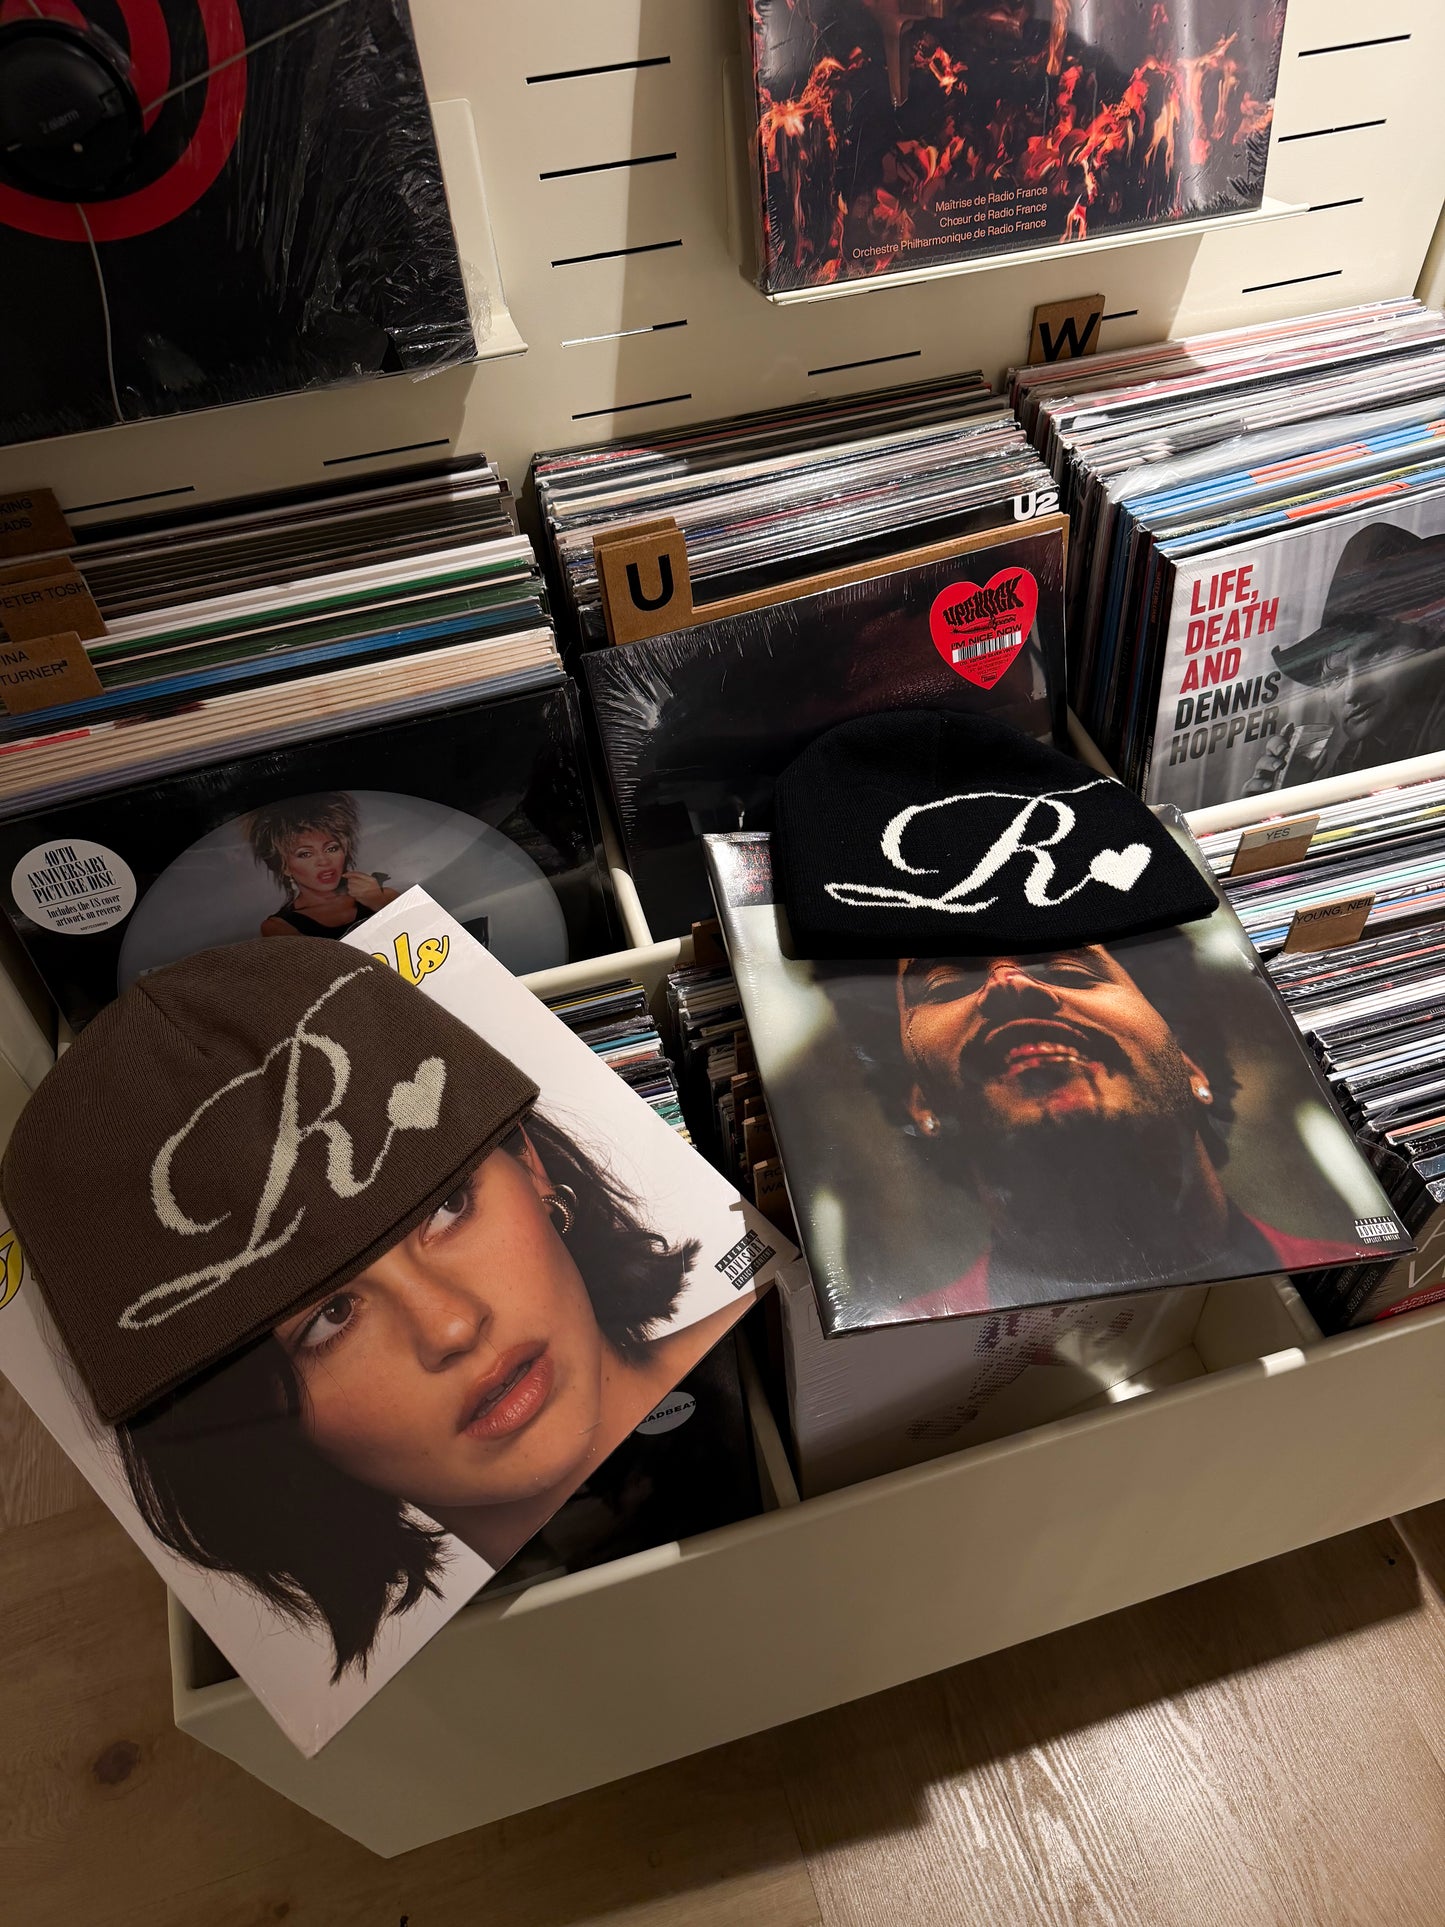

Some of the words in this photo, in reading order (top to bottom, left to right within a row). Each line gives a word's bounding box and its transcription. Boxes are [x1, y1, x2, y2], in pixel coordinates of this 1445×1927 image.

[935, 199, 973, 212] Maîtrise
[974, 196, 987, 206] de
[988, 192, 1014, 204] Radio
[1016, 186, 1048, 198] France
[939, 214, 972, 229] Chœur
[974, 211, 986, 222] de
[988, 207, 1014, 220] Radio
[1015, 202, 1047, 215] France
[852, 243, 899, 259] Orchestre
[901, 232, 972, 251] Philharmonique
[973, 227, 986, 238] de
[988, 223, 1014, 236] Radio
[1015, 219, 1047, 232] France
[1039, 312, 1101, 362] W
[1013, 490, 1060, 521] U2
[45, 581, 90, 598] TOSH
[625, 554, 674, 612] U
[1190, 564, 1259, 616] LIFE,
[951, 641, 965, 649] I'M
[969, 632, 993, 644] NICE
[996, 624, 1022, 637] NOW
[1185, 597, 1280, 656] DEATH
[1180, 647, 1242, 694] AND
[1174, 671, 1281, 731] DENNIS
[1169, 706, 1280, 766] HOPPER
[1266, 828, 1291, 841] YES
[44, 846, 78, 867] 40TH
[27, 855, 108, 889] ANNIVERSARY
[32, 878, 89, 904] PICTURE
[86, 870, 117, 891] DISC
[47, 905, 78, 919] Includes
[78, 901, 91, 911] the
[90, 898, 100, 908] US
[101, 894, 120, 905] cover
[56, 913, 85, 927] artwork
[86, 911, 96, 920] on
[96, 904, 122, 917] reverse
[1296, 907, 1343, 926] YOUNG,
[1347, 896, 1376, 912] NEIL
[1354, 1216, 1391, 1226] PARENTAL
[1357, 1222, 1398, 1238] ADVISORY
[717, 1232, 756, 1271] PARENTAL
[1363, 1235, 1382, 1245] EXPLICIT
[1382, 1233, 1400, 1242] CONTENT
[724, 1237, 766, 1281] ADVISORY
[734, 1265, 755, 1288] EXPLICIT
